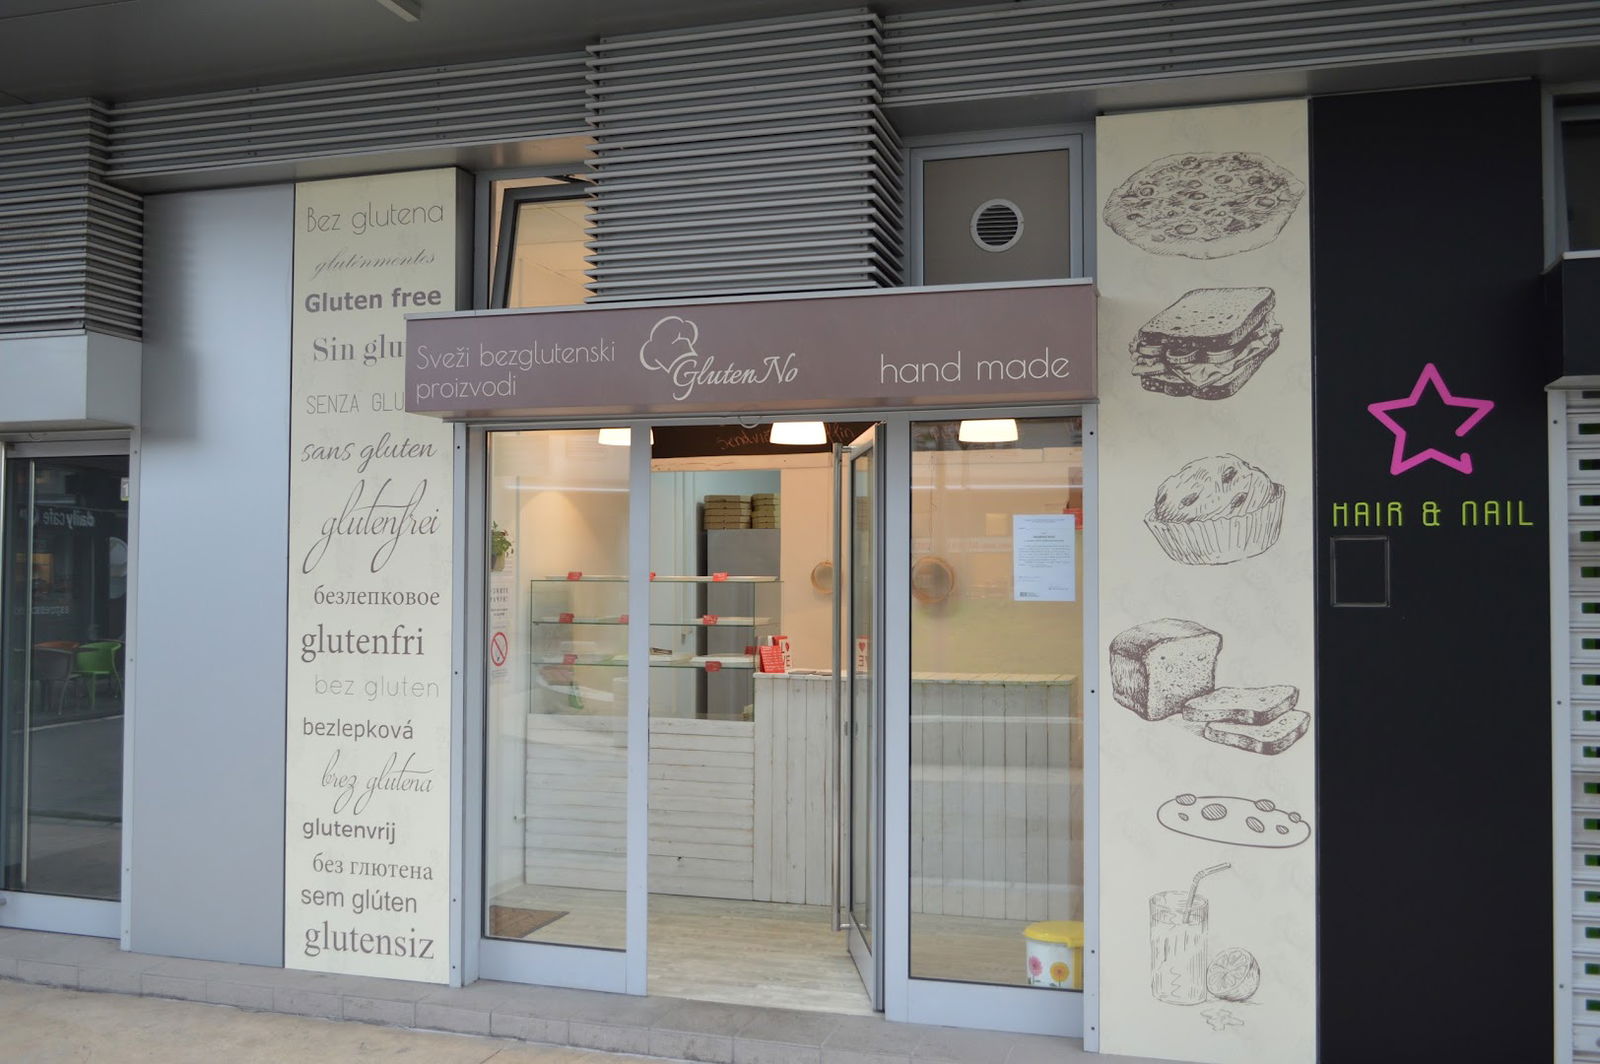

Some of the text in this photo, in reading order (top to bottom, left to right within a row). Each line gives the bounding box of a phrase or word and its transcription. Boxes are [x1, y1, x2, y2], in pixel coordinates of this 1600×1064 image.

[306, 201, 444, 236] Bez glutena
[304, 287, 442, 314] Gluten free
[312, 333, 405, 367] Sin glu
[416, 338, 616, 372] Sveži bezglutenski
[880, 347, 1070, 384] hand made
[306, 391, 405, 415] SENZA GLU
[416, 371, 517, 405] proizvodi
[301, 431, 438, 475] sans gluten
[302, 477, 441, 575] glutenfrei
[1332, 500, 1534, 528] HAIR & NAIL
[313, 584, 441, 606] безлепковое
[300, 623, 425, 664] glutenfri
[314, 674, 440, 702] bez gluten
[303, 717, 414, 742] bezlepková
[320, 749, 435, 816] brez glutena
[302, 818, 397, 845] glutenvrij
[312, 852, 435, 881] без глютена
[300, 888, 418, 915] sem glúten
[303, 920, 436, 961] glutensiz
